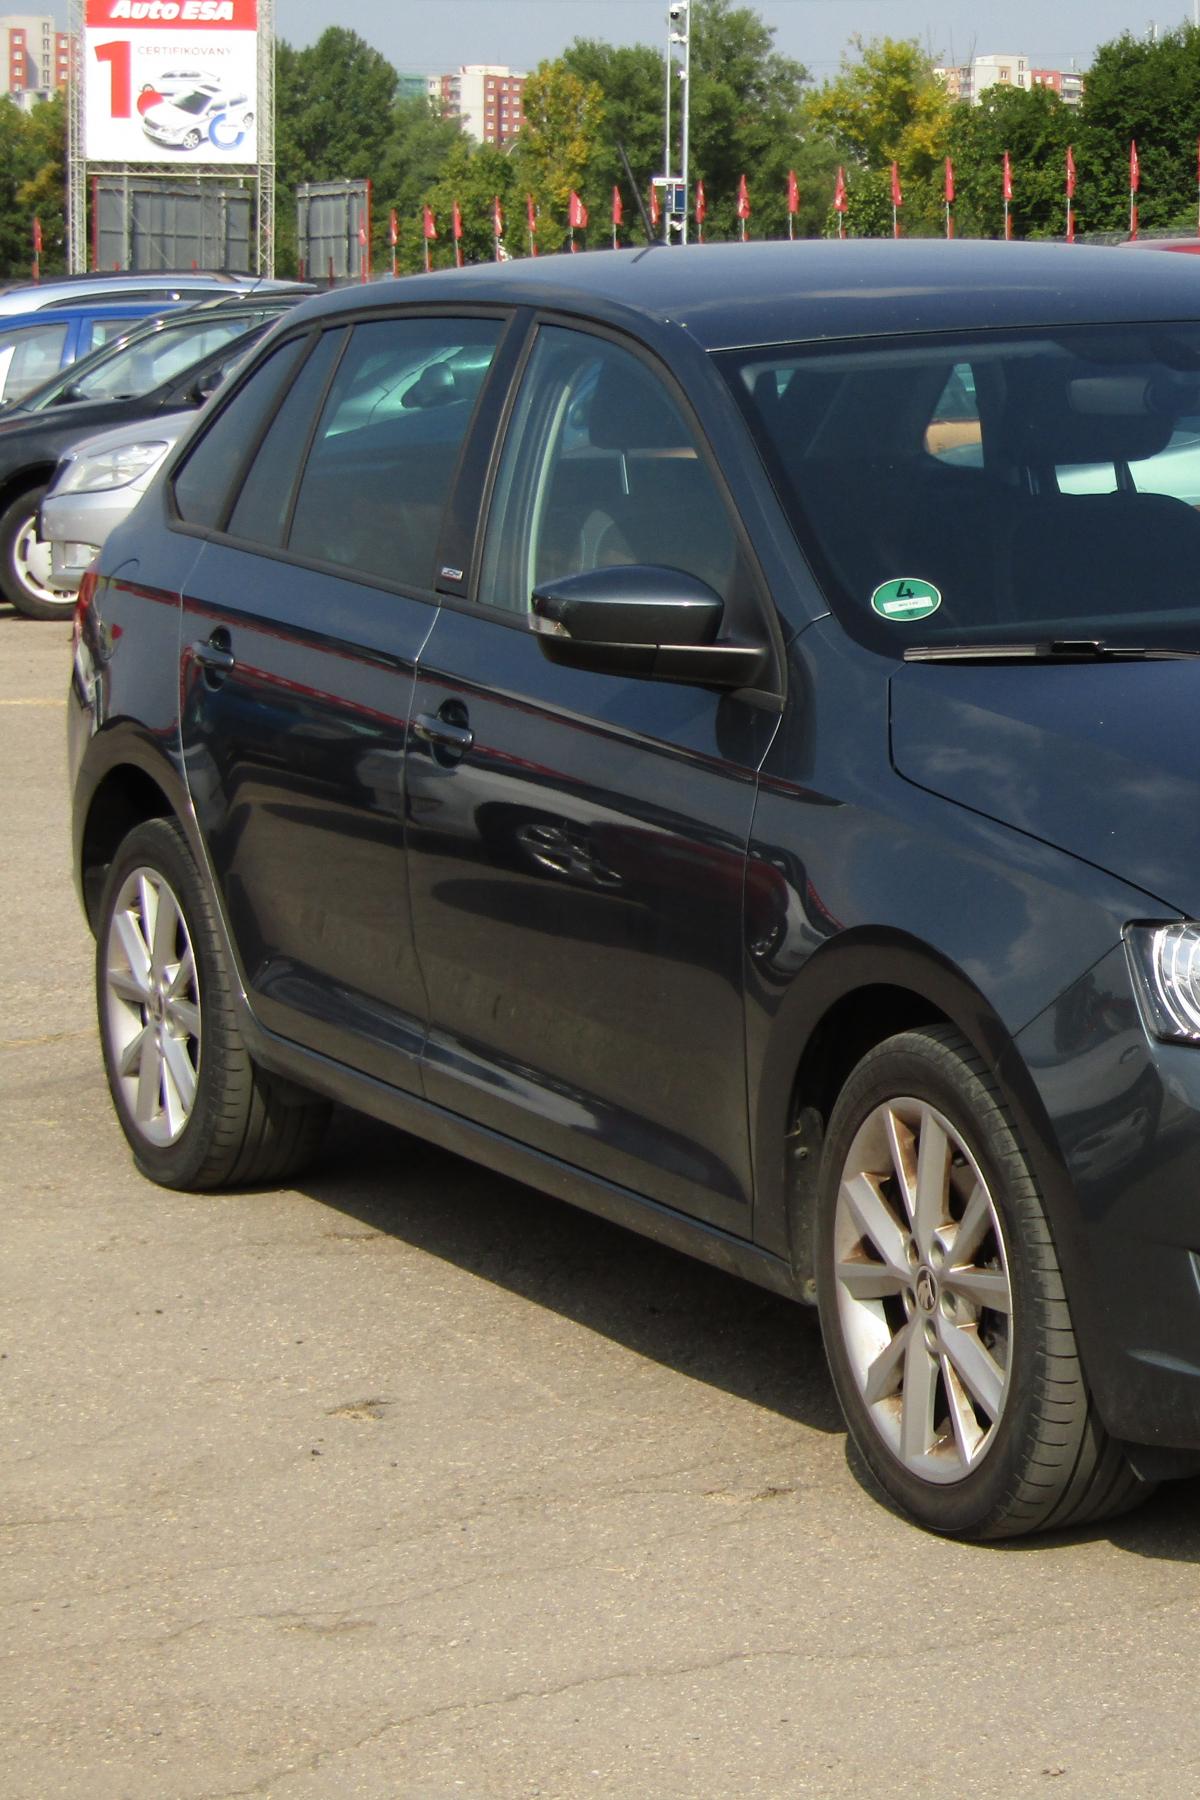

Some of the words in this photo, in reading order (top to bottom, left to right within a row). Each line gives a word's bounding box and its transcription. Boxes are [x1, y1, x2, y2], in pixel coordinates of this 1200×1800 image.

[109, 0, 180, 20] Auto
[181, 1, 235, 21] ESA
[94, 41, 131, 118] 1
